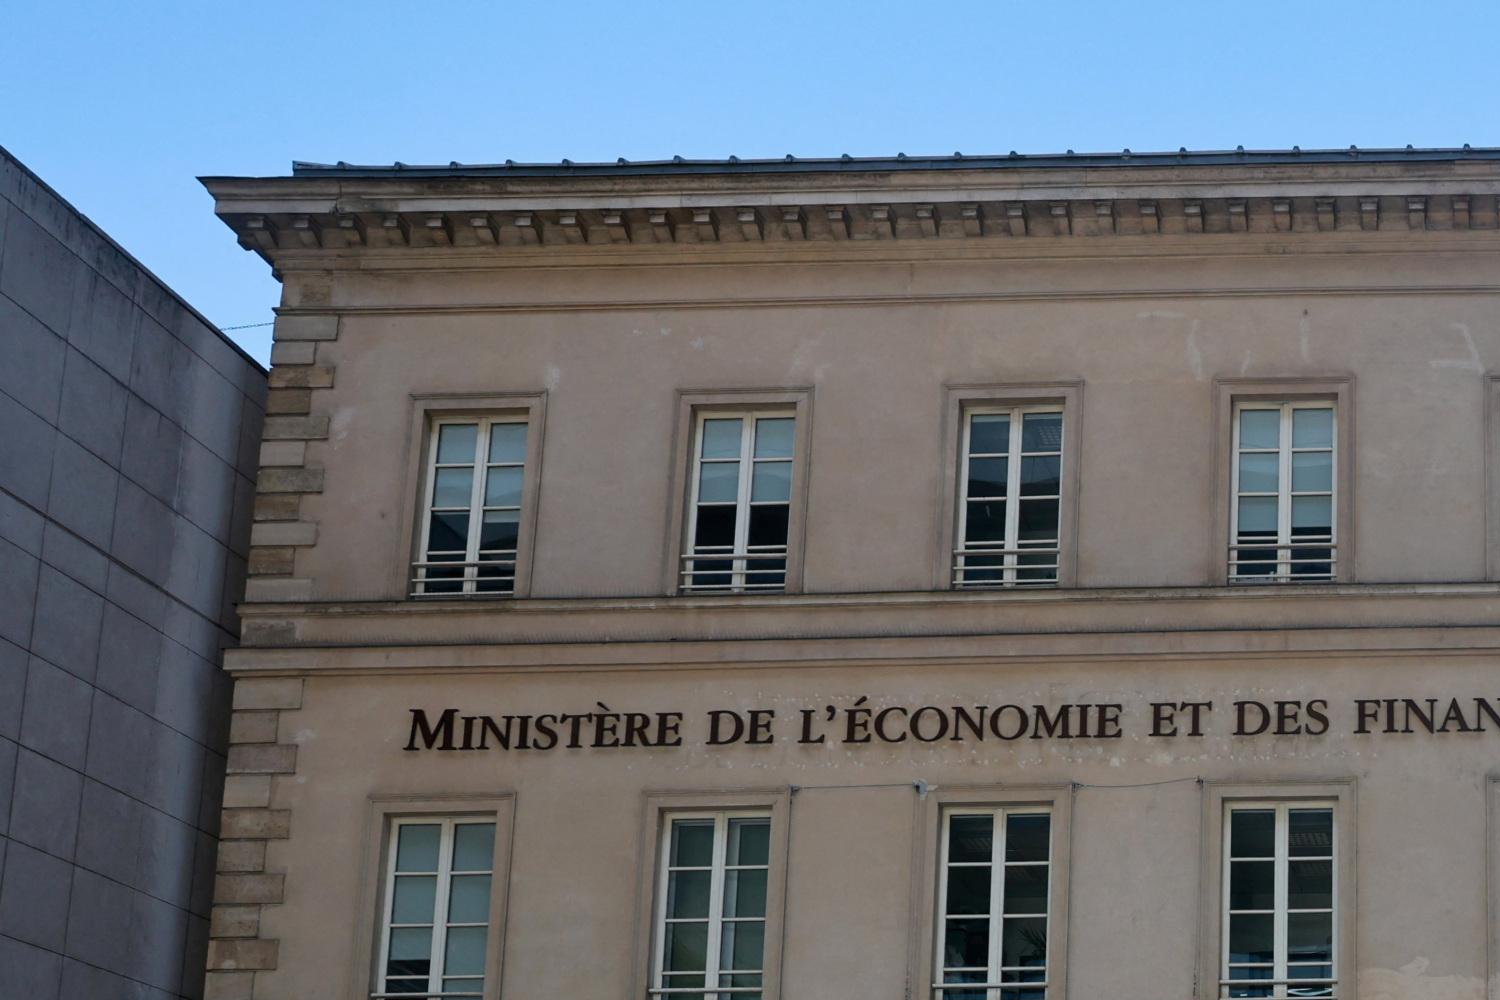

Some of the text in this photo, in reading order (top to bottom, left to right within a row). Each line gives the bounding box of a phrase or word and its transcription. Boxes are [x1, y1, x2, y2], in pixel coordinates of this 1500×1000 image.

[403, 701, 683, 752] MINISTÈRE
[705, 709, 775, 746] DE
[798, 695, 1123, 745] L'ÉCONOMIE
[1148, 700, 1212, 738] ET
[1232, 699, 1330, 737] DES
